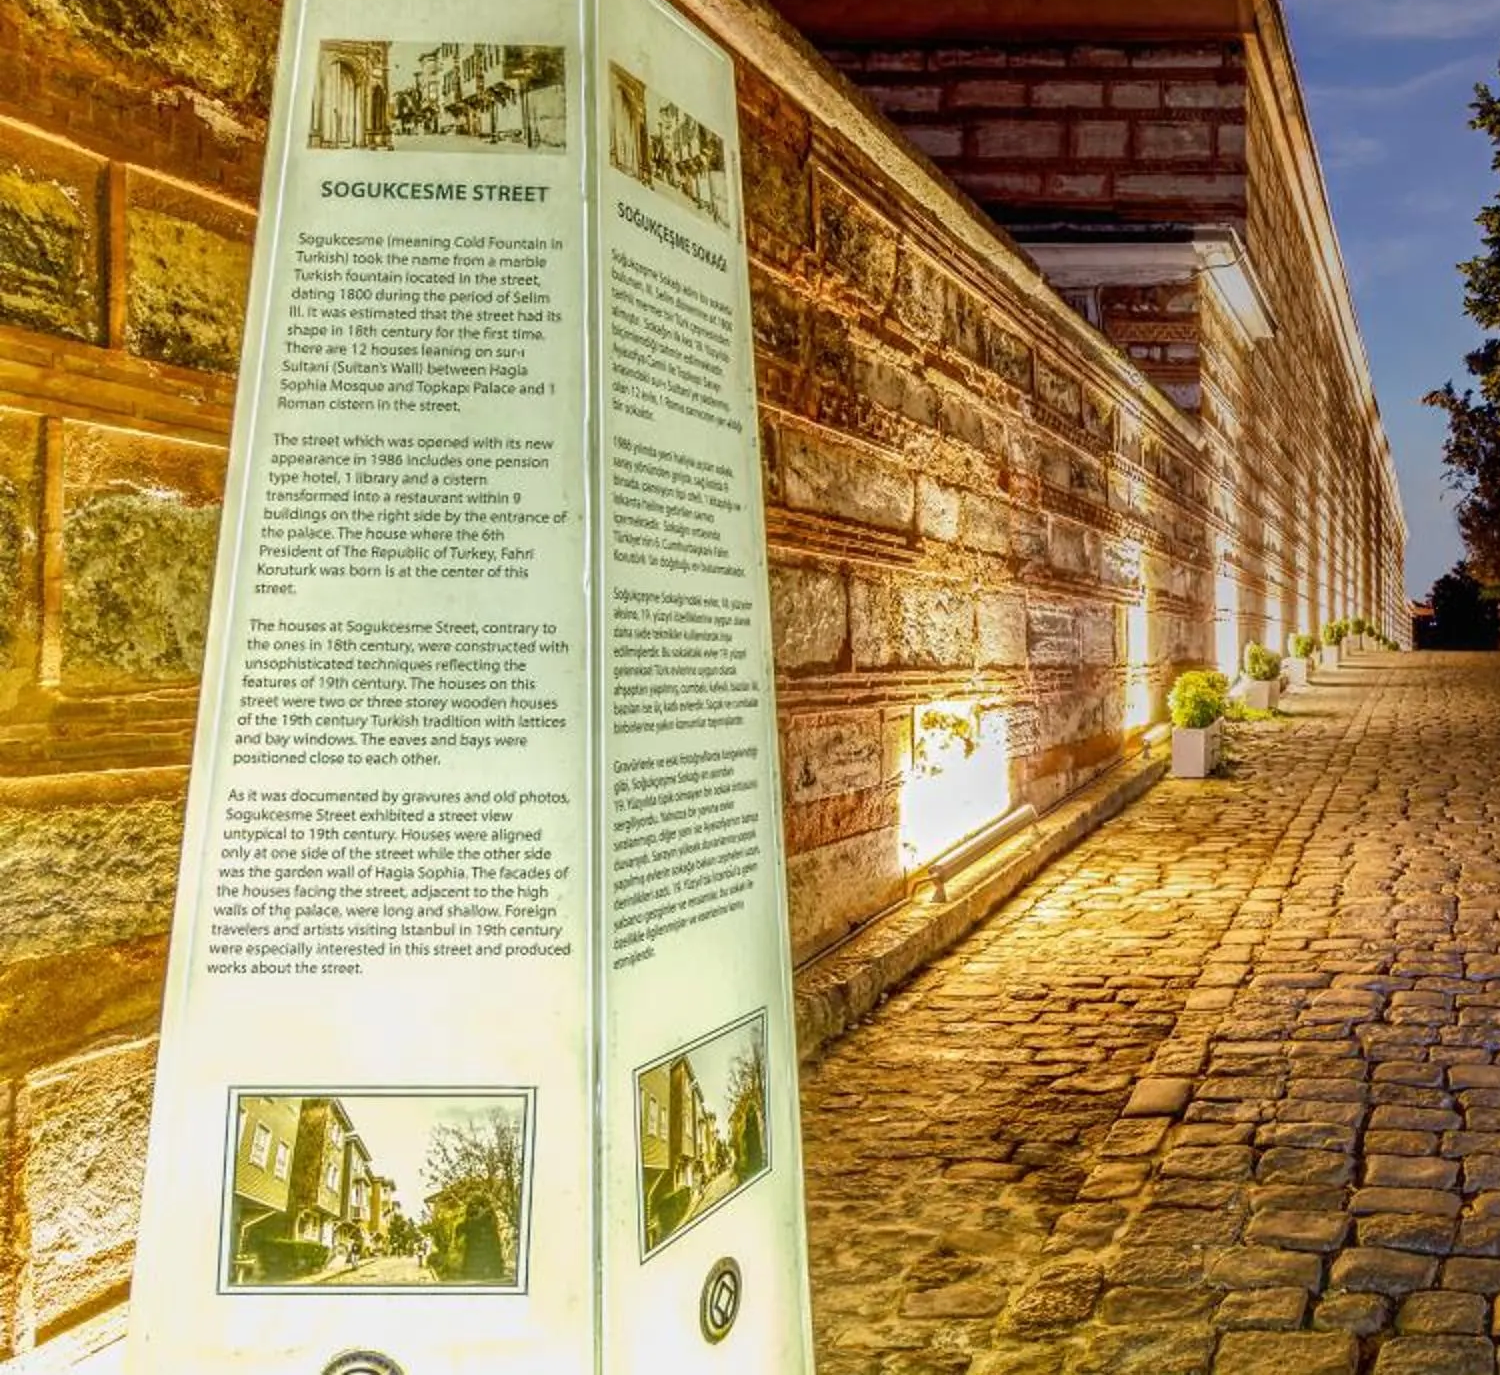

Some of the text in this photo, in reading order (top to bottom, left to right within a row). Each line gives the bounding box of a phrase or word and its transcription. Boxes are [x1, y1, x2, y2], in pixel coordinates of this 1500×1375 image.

[320, 181, 550, 202] SOGUKCESME STREET
[453, 236, 485, 247] Cold
[487, 236, 547, 249] Fountain
[550, 237, 563, 249] in
[352, 251, 383, 263] took
[386, 252, 408, 264] the
[410, 256, 450, 265] name
[452, 253, 484, 265] from
[498, 254, 547, 266] marble
[294, 269, 343, 281] Turkish
[344, 270, 402, 282] fountain
[404, 271, 455, 283] located
[458, 272, 471, 283] in
[474, 272, 497, 284] the
[291, 287, 550, 305] dating 1800 during the period of Selim
[319, 309, 346, 318] was
[349, 307, 417, 319] estimated
[419, 308, 447, 319] that
[450, 308, 473, 320] the
[476, 308, 514, 320] street
[516, 309, 543, 321] had
[546, 309, 562, 321] its
[287, 324, 328, 339] shape
[330, 324, 343, 336] in
[380, 325, 433, 341] century
[435, 326, 454, 337] for
[457, 326, 480, 338] the
[482, 327, 508, 338] first
[274, 433, 554, 451] The street which was opened with its new
[270, 453, 549, 470] appearance in 1986 includes one pension
[268, 470, 299, 485] type
[355, 471, 399, 486] library
[401, 472, 429, 483] and
[442, 472, 488, 484] cistern
[263, 508, 567, 524] buildings on the right side by the entrance of
[260, 526, 284, 537] the
[338, 527, 363, 538] The
[364, 527, 408, 538] house
[409, 527, 453, 539] where
[455, 528, 479, 539] the
[480, 528, 504, 539] 6th
[250, 620, 275, 631] The
[277, 620, 326, 631] houses
[328, 620, 343, 631] at
[481, 621, 538, 636] contrary
[543, 622, 556, 633] to
[246, 639, 270, 650] the
[272, 642, 306, 650] ones
[308, 639, 322, 650] in
[417, 643, 452, 651] were
[454, 640, 536, 652] constructed
[538, 640, 568, 652] with
[244, 657, 526, 673] unsophisticated techniques reflecting the
[234, 733, 262, 744] and
[264, 733, 291, 748] bay
[360, 733, 386, 745] The
[388, 737, 427, 745] eaves
[429, 734, 457, 745] and
[459, 734, 491, 748] bays
[493, 737, 528, 745] were
[232, 751, 307, 766] positioned
[308, 751, 344, 763] close
[346, 752, 363, 763] to
[364, 752, 398, 763] each
[315, 809, 356, 820] Street
[359, 809, 424, 820] exhibited
[438, 809, 478, 821] street
[480, 809, 513, 821] view
[223, 828, 287, 842] untypical
[289, 828, 305, 839] to
[309, 828, 339, 839] 19th
[400, 828, 451, 839] Houses
[453, 831, 488, 840] were
[490, 828, 542, 843] aligned
[211, 923, 563, 938] travelers and artists visiting Istanbul in 19th century
[208, 943, 571, 958] were especially interested in this street and produced
[206, 961, 247, 972] works
[250, 961, 292, 972] about
[294, 961, 318, 973] the
